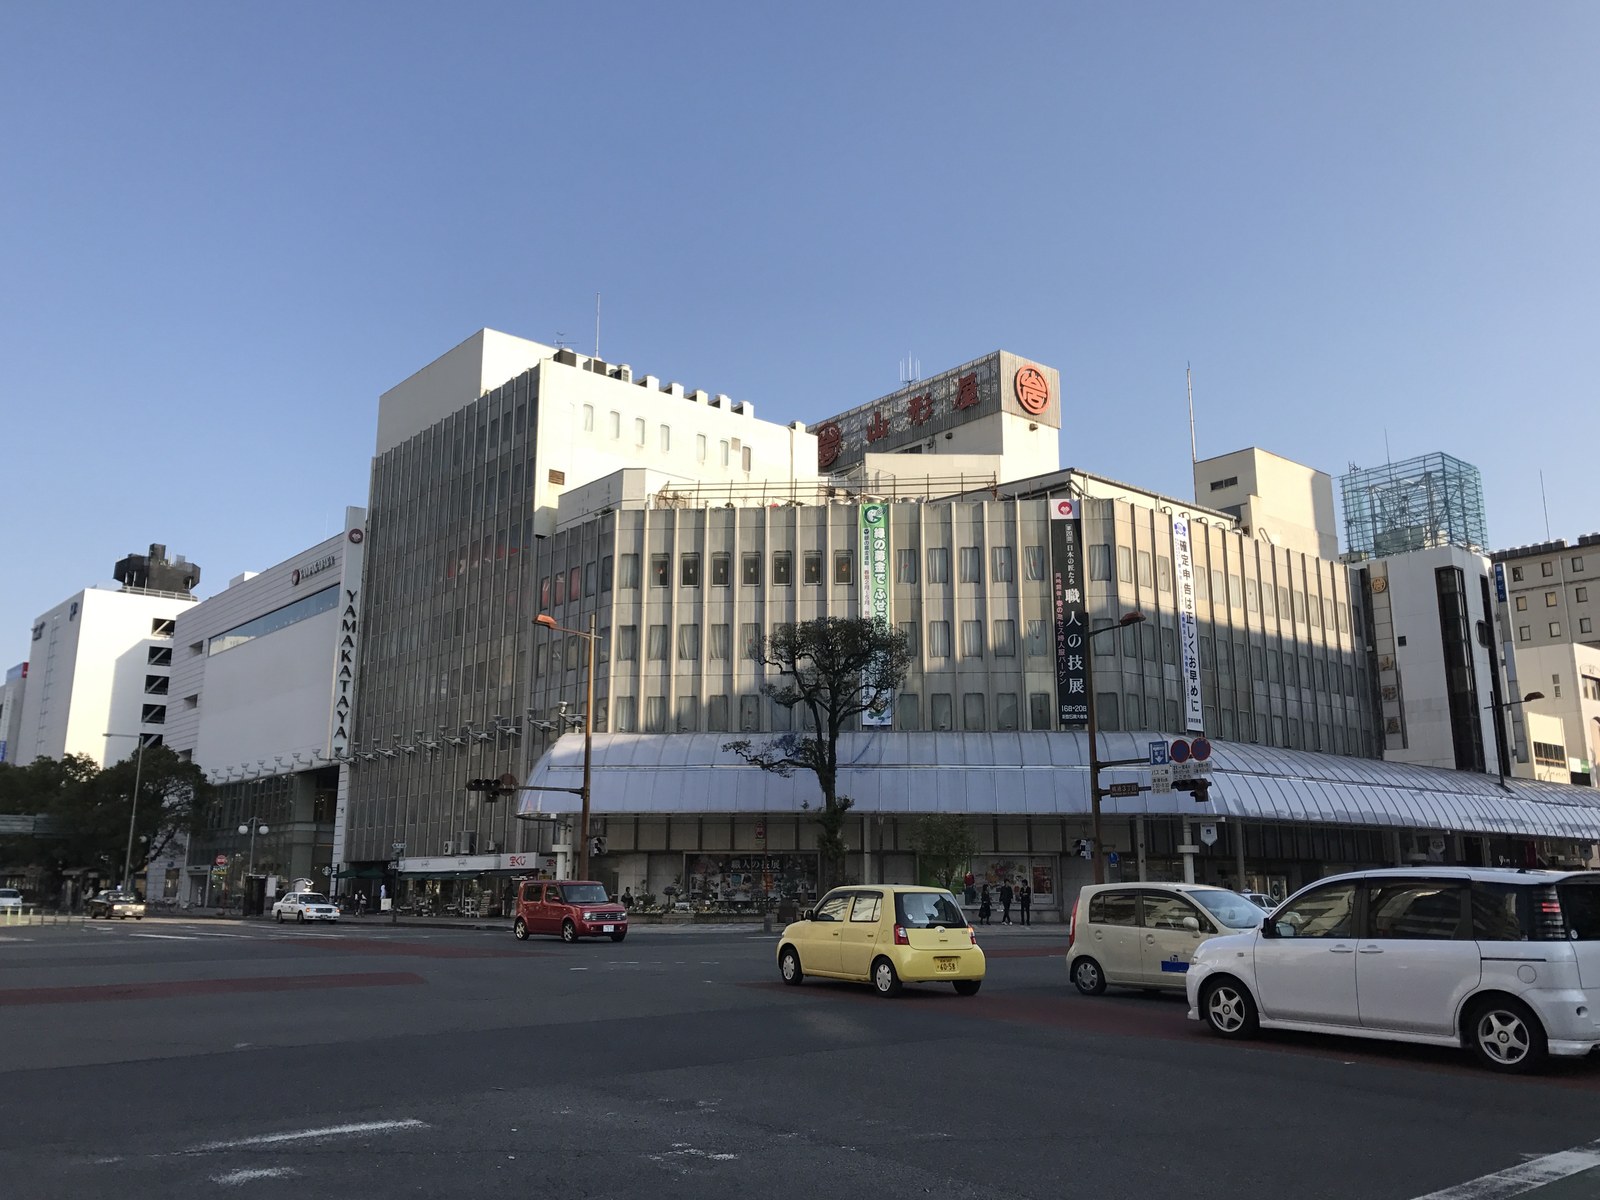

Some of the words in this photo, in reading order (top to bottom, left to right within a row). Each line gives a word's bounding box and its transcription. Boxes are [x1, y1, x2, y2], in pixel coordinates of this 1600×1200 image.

[866, 371, 981, 443] 山形屋
[873, 526, 887, 584] 緑の募金で
[333, 589, 358, 740] YAMAKATAYA
[1065, 588, 1085, 694] 職人の技展
[1179, 539, 1200, 713] 確定申告は正しくお早めに
[509, 855, 527, 867] 宝くじ
